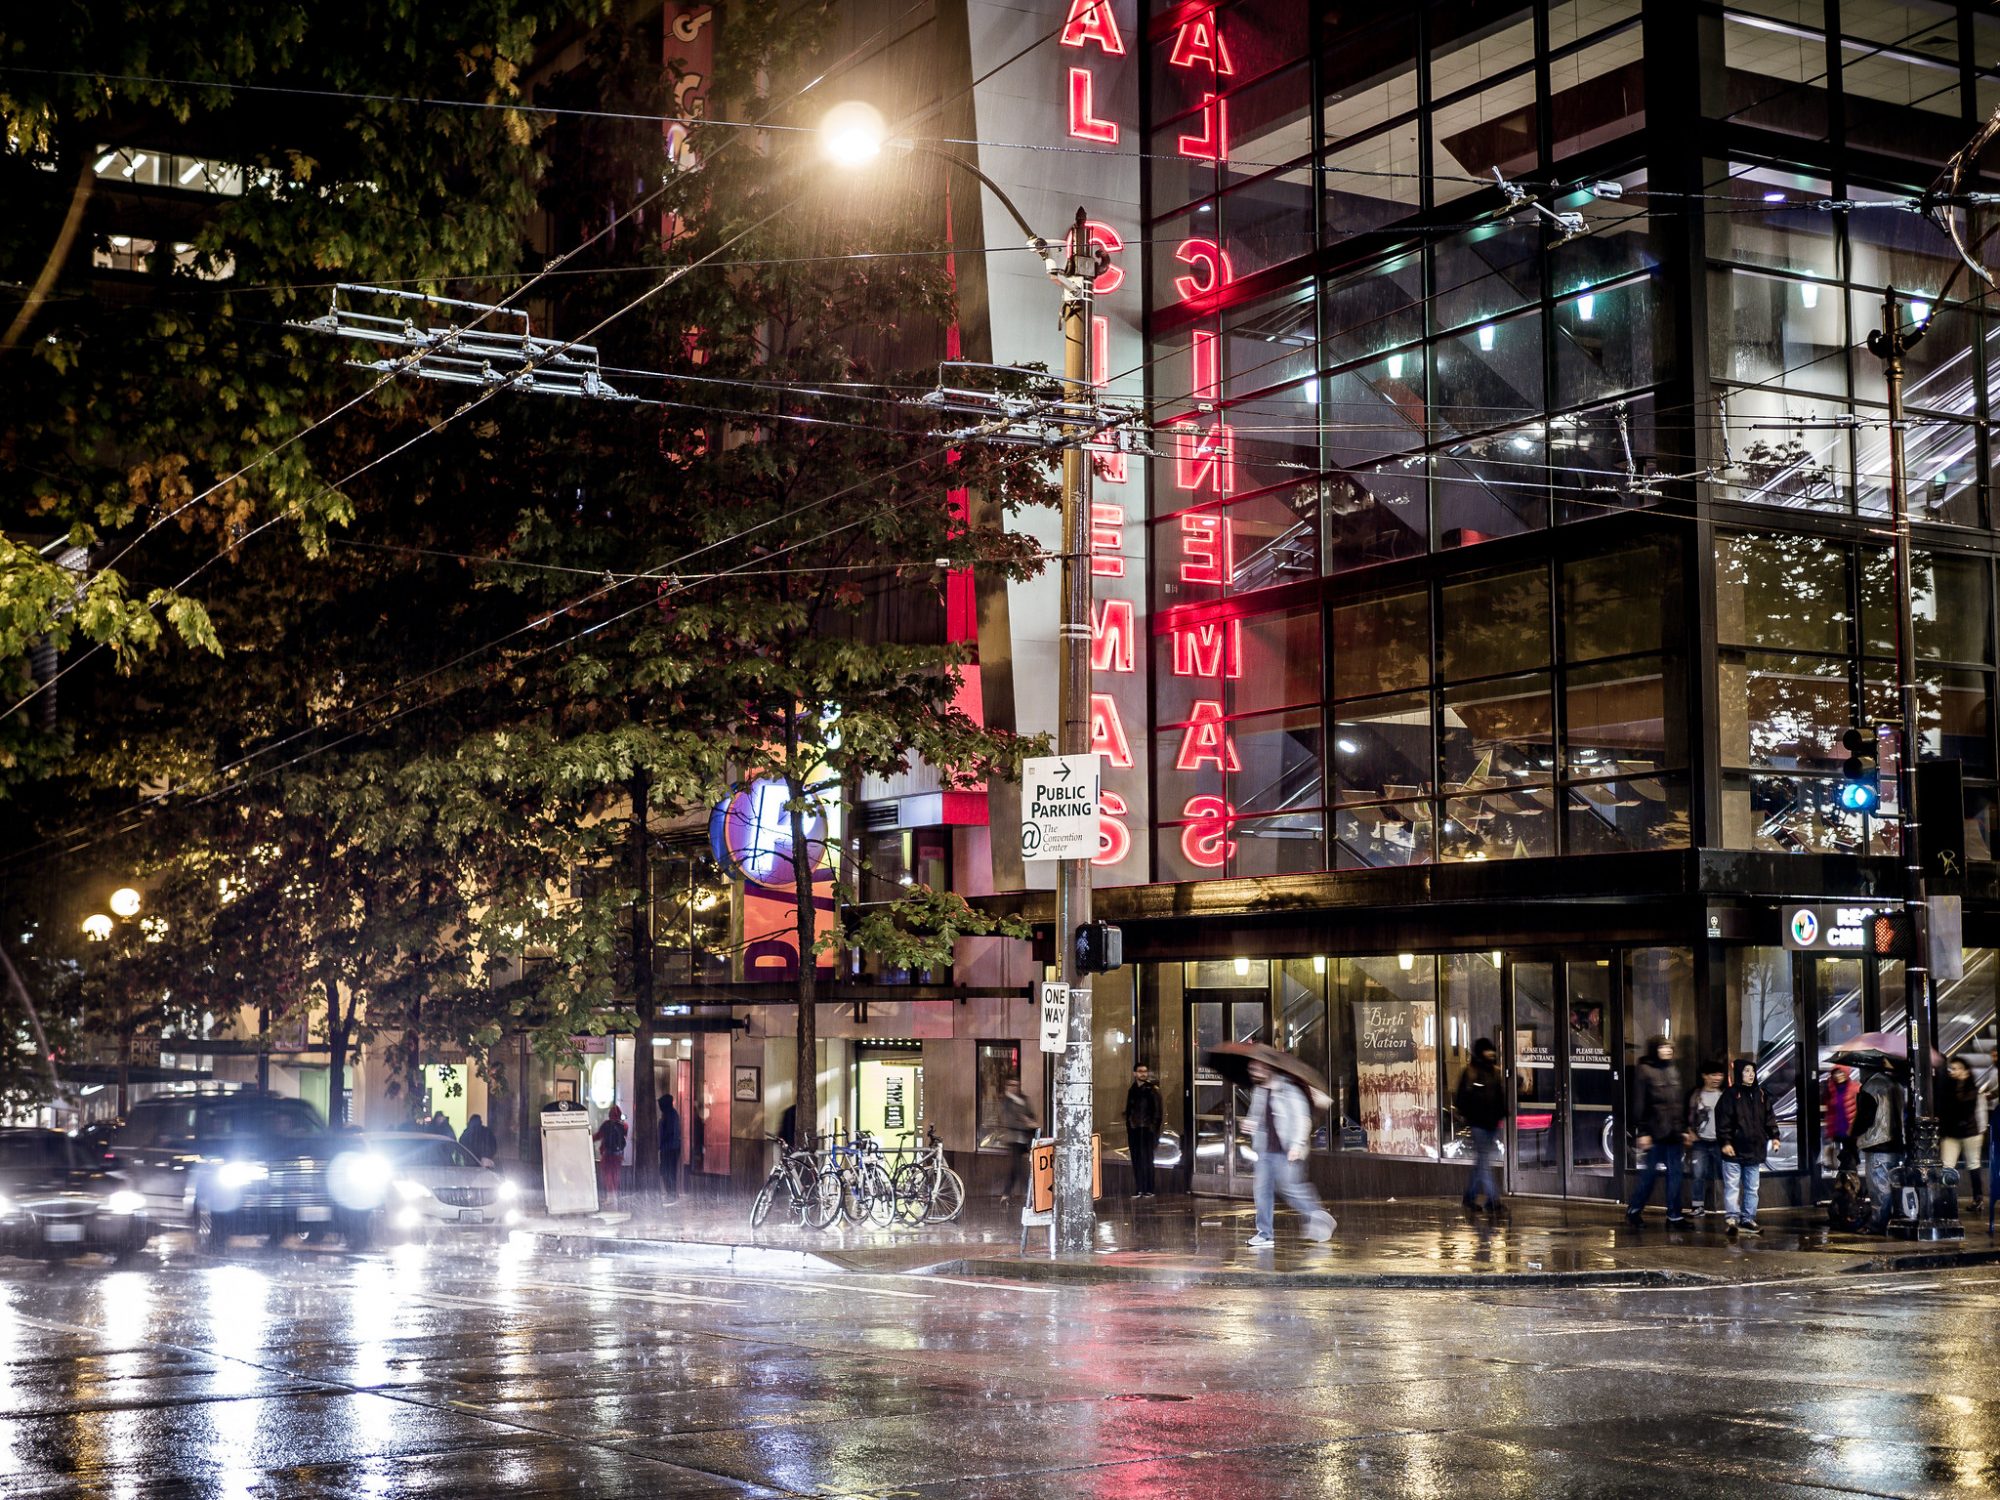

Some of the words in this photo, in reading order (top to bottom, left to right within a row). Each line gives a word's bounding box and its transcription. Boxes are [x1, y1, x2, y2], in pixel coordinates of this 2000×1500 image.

[1036, 784, 1086, 802] PUBLIC
[1031, 801, 1092, 819] PARKING
[1043, 824, 1059, 833] The
[1043, 832, 1083, 844] Convention
[1043, 843, 1068, 853] Center
[1045, 988, 1066, 1005] ONE
[1044, 1007, 1066, 1024] WAY
[1370, 1006, 1407, 1027] Birth
[131, 1040, 161, 1053] PIKE
[1363, 1028, 1407, 1049] Nation
[131, 1053, 160, 1065] PINE
